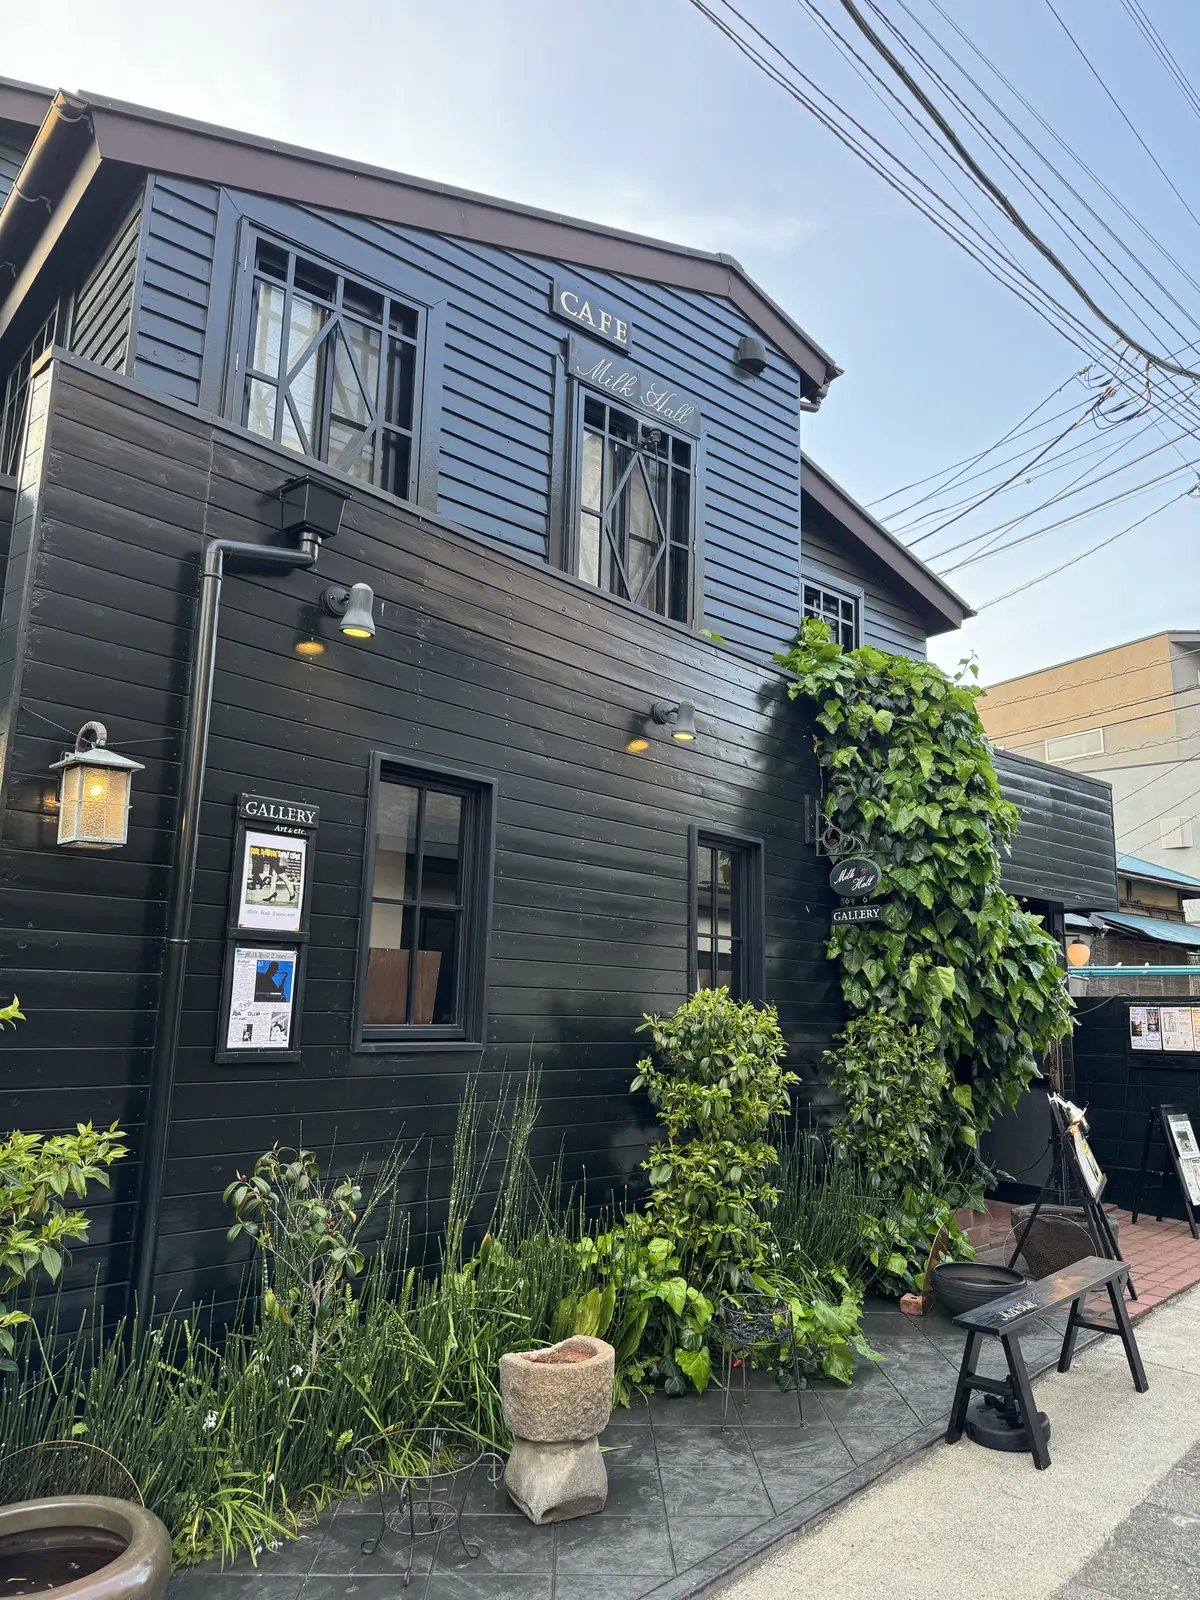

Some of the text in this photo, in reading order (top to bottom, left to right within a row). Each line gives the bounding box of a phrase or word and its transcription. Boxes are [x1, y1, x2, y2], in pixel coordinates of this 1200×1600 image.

[560, 291, 628, 344] CAFE
[576, 358, 695, 424] Milk Hall
[245, 801, 317, 824] GALLERY
[274, 824, 287, 833] Art
[833, 867, 856, 885] Milk
[851, 875, 876, 891] Hall
[833, 908, 880, 921] GALLERY
